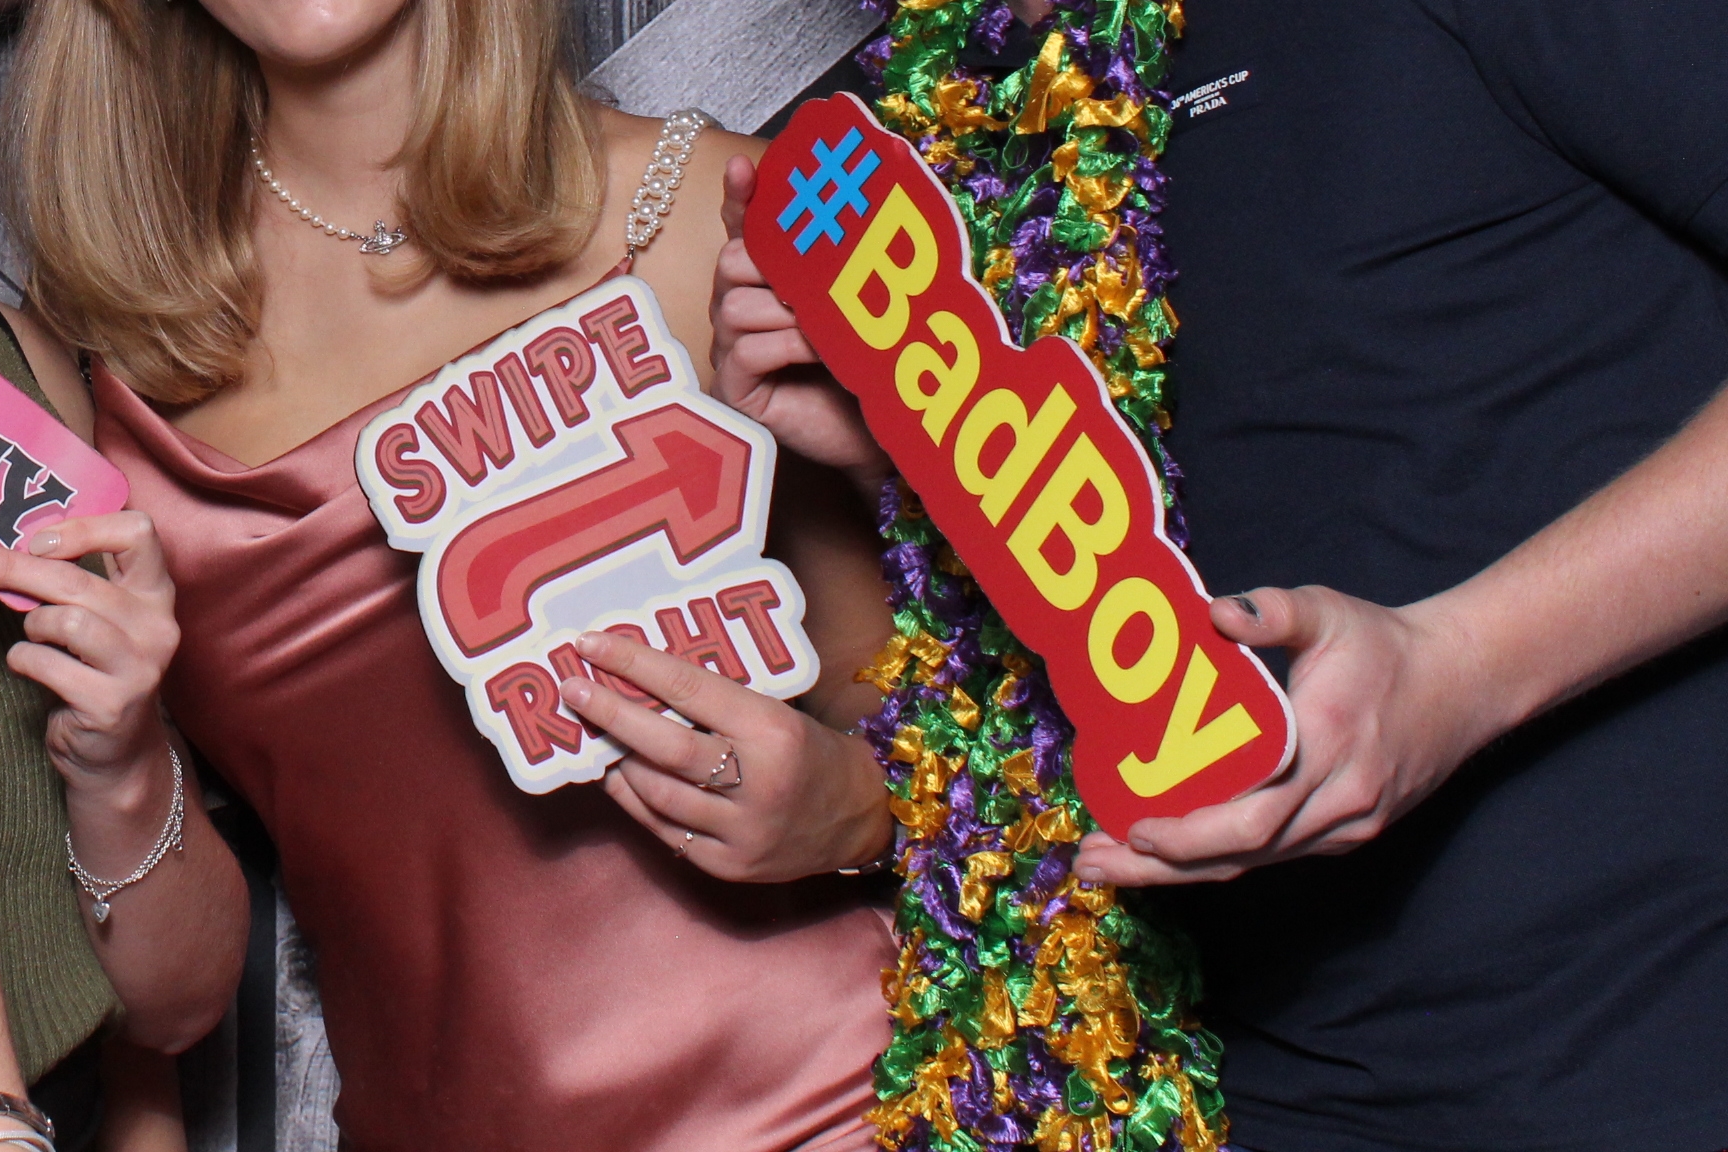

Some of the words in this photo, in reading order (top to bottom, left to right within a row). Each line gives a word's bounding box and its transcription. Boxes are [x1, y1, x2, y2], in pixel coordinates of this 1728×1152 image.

[1184, 77, 1228, 104] AMERICA'S
[1228, 70, 1249, 85] CUP
[1189, 96, 1227, 117] PRADA
[375, 295, 671, 523] SWIPE
[776, 126, 1262, 797] #BadBoy
